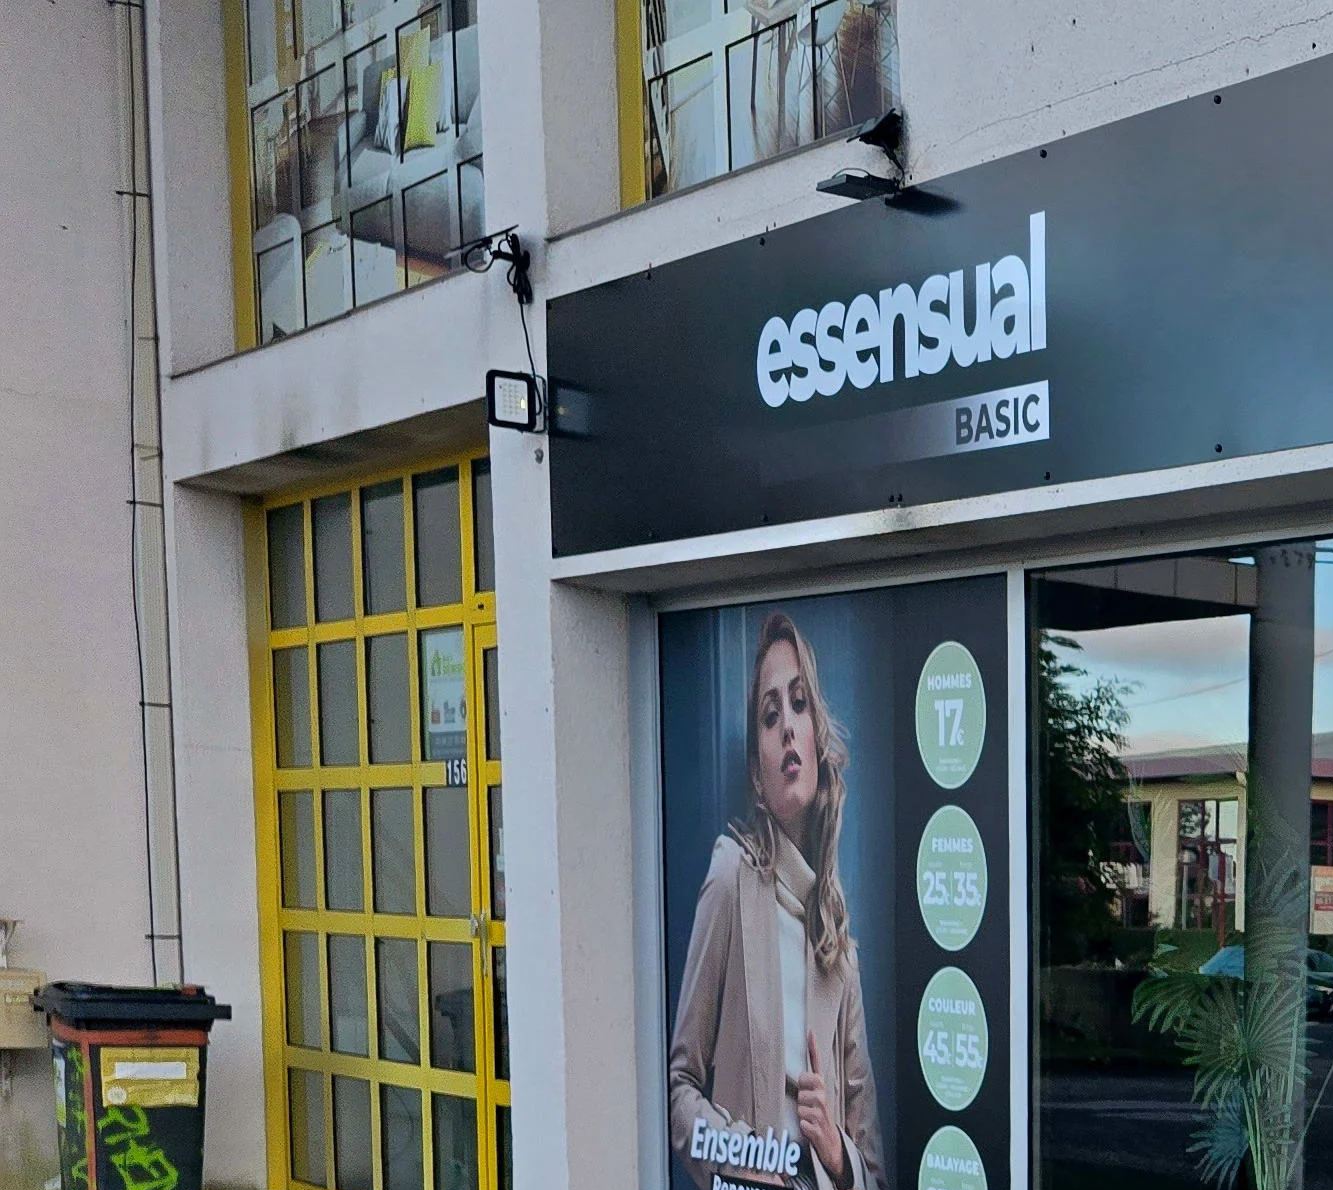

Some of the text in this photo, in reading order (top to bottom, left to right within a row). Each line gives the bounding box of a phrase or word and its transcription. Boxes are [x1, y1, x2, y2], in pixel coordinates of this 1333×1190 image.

[757, 210, 1047, 408] essensual
[955, 393, 1041, 446] BASIC
[927, 673, 972, 691] HOMMES
[447, 758, 467, 785] 156
[931, 837, 973, 853] FEMMES
[928, 997, 976, 1015] COULEUR
[690, 1117, 801, 1176] Ensemble
[926, 1153, 980, 1176] BALAYAGE
